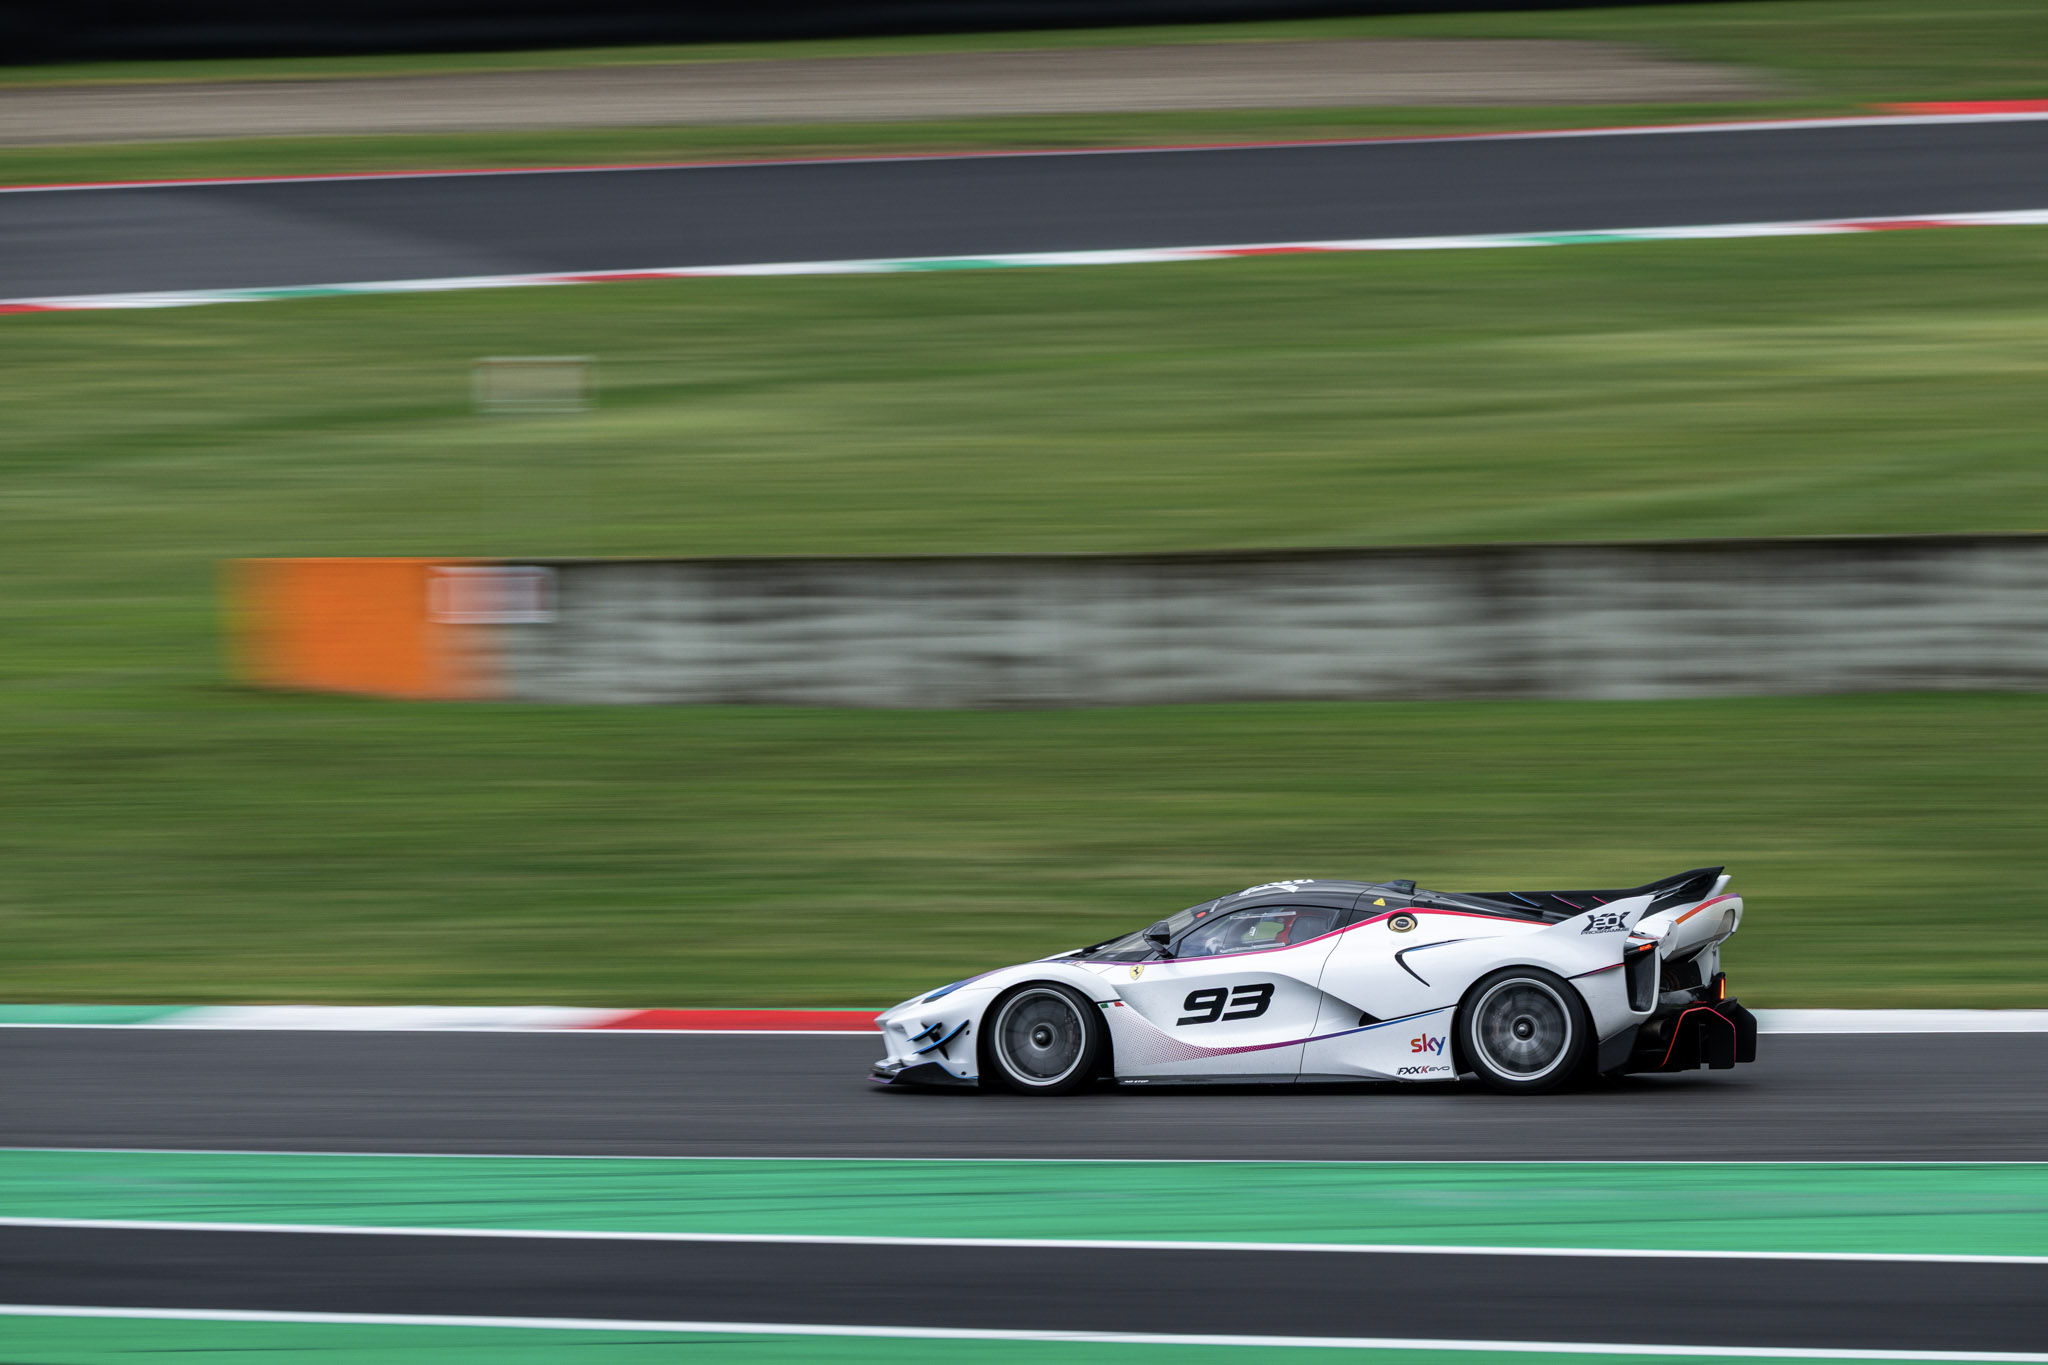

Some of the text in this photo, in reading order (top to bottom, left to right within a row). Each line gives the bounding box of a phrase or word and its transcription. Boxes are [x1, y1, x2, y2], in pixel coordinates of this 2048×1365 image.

[1592, 915, 1621, 928] 20
[1176, 982, 1275, 1026] 93
[1410, 1033, 1446, 1056] sky
